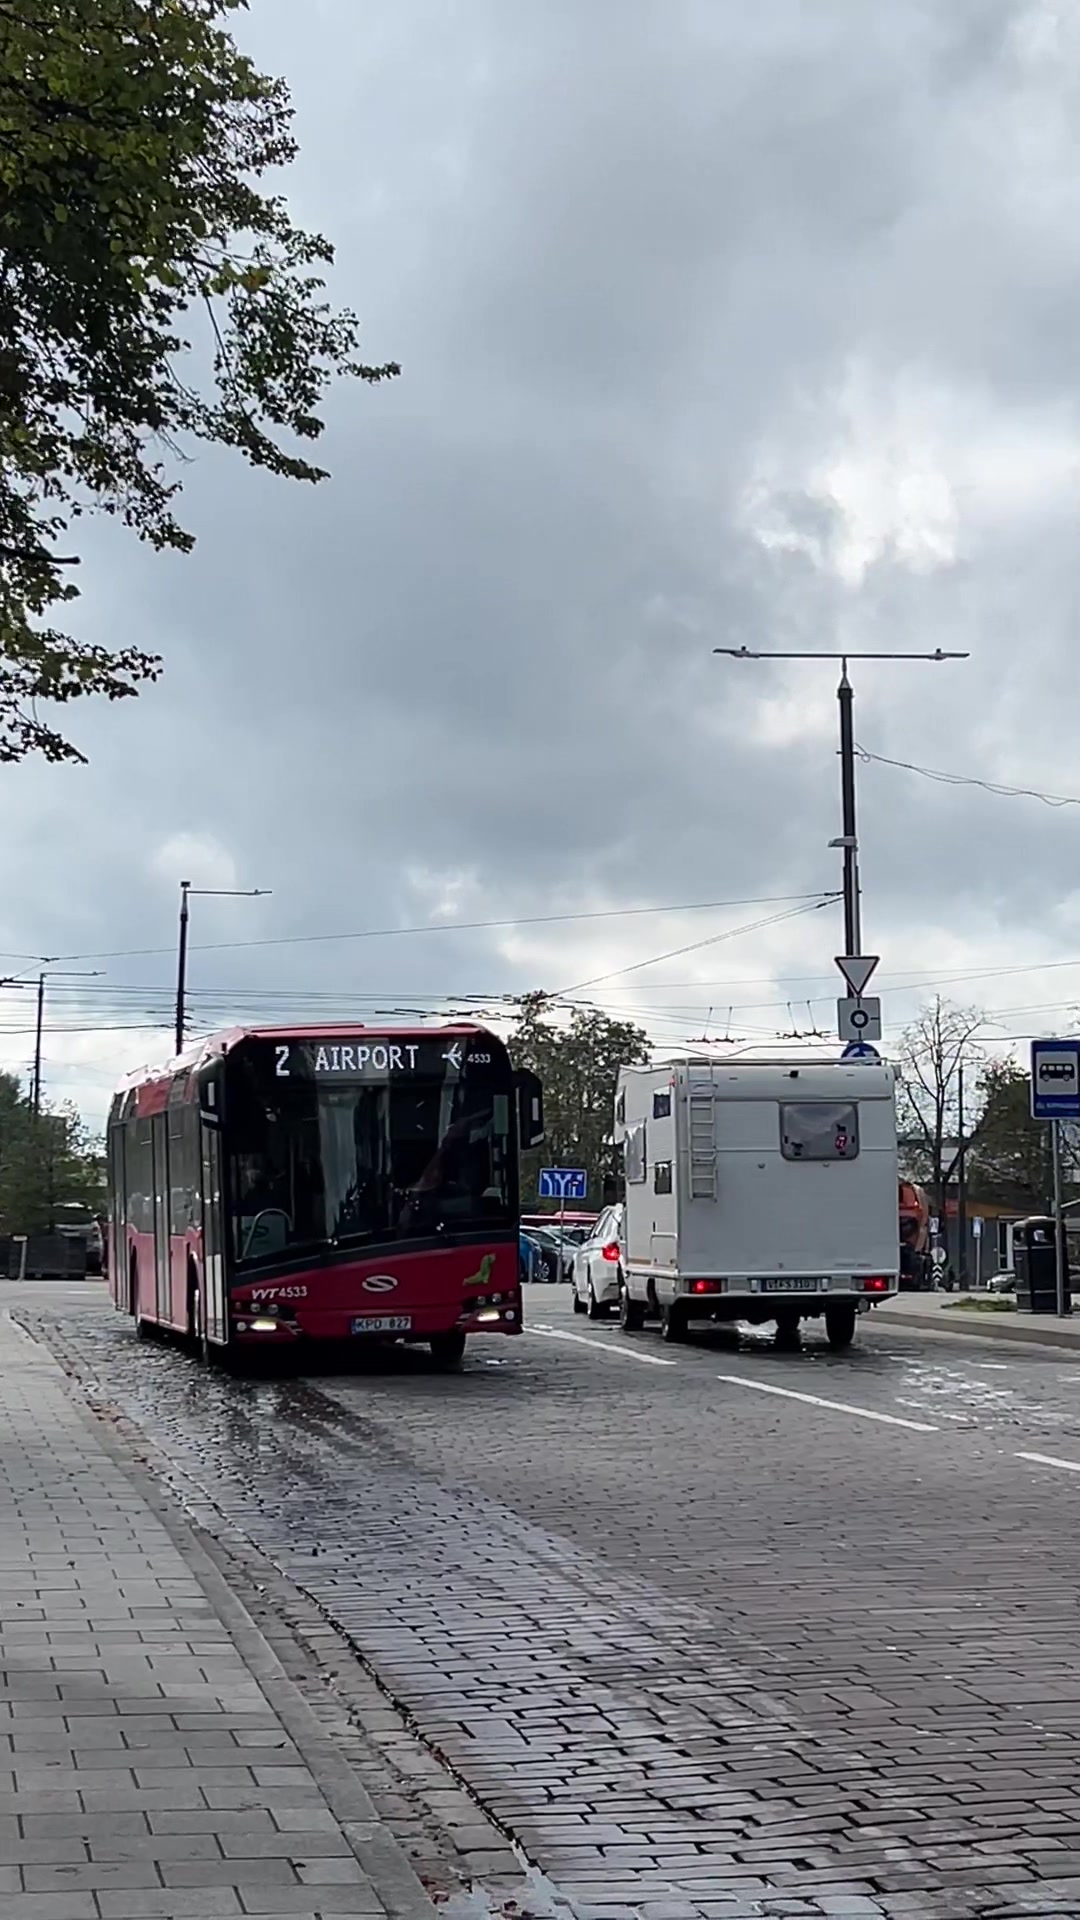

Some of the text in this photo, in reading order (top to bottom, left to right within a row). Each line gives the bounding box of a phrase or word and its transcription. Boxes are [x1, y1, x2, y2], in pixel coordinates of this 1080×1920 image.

[275, 1045, 419, 1076] 2 AIRPORT
[467, 1053, 491, 1064] 4533
